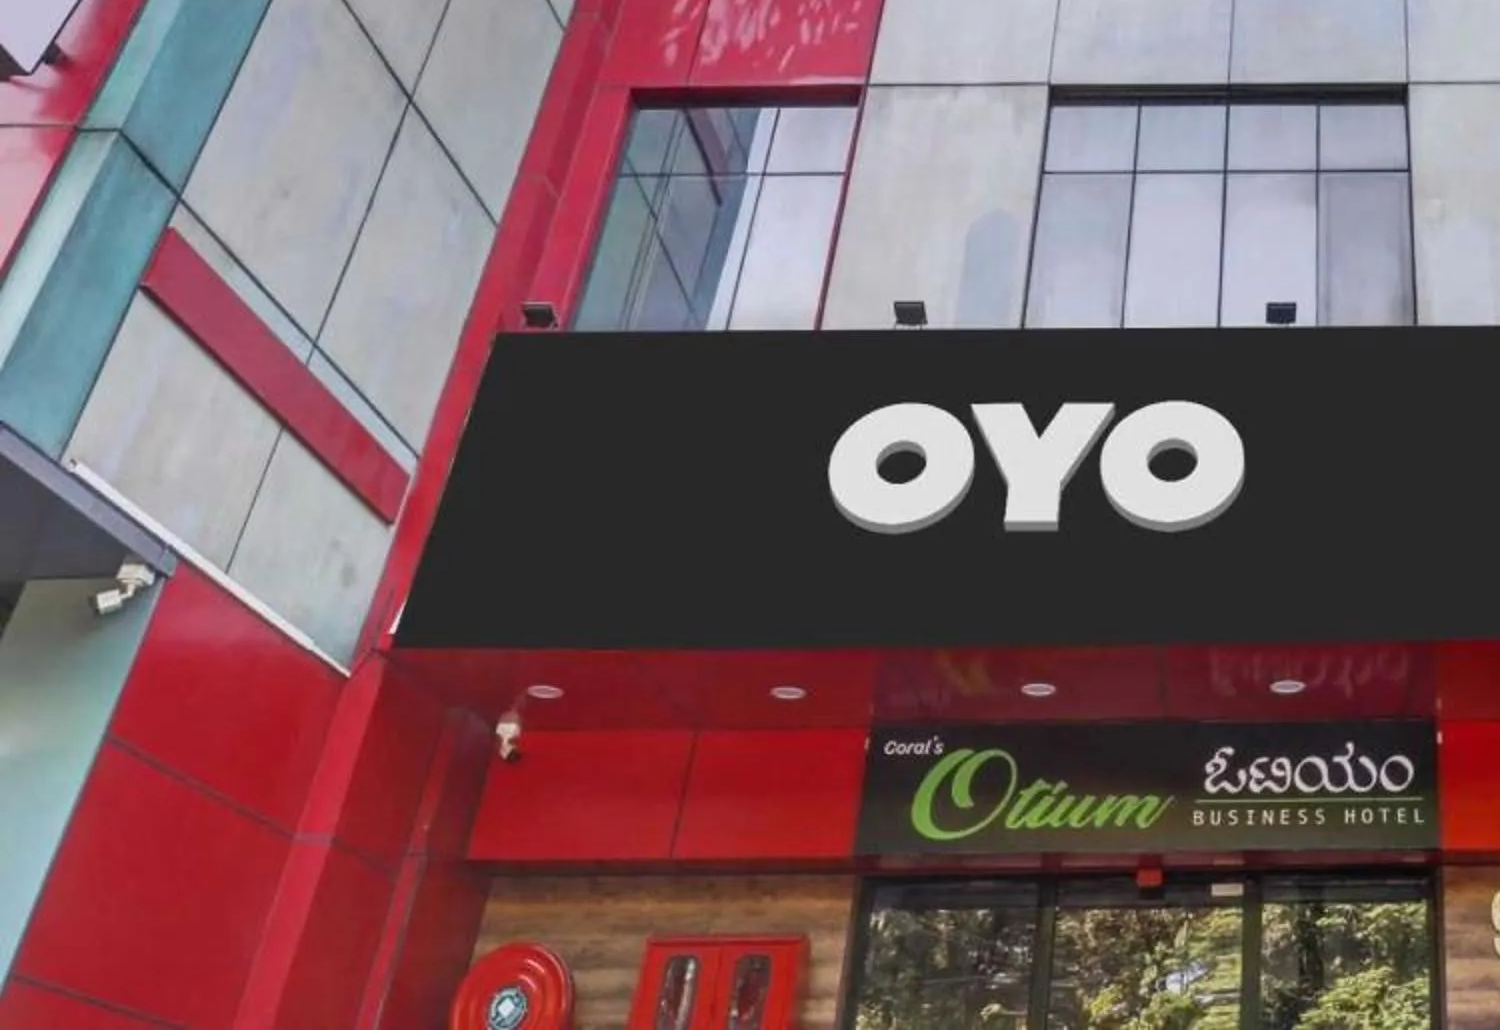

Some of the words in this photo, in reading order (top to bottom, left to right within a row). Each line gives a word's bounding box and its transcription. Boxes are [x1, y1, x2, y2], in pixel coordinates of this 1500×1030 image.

[828, 400, 1245, 534] OYO
[884, 735, 943, 755] Coral's
[911, 748, 1175, 840] Otium
[1193, 808, 1326, 826] BUSINESS
[1344, 807, 1424, 825] HOTEL
